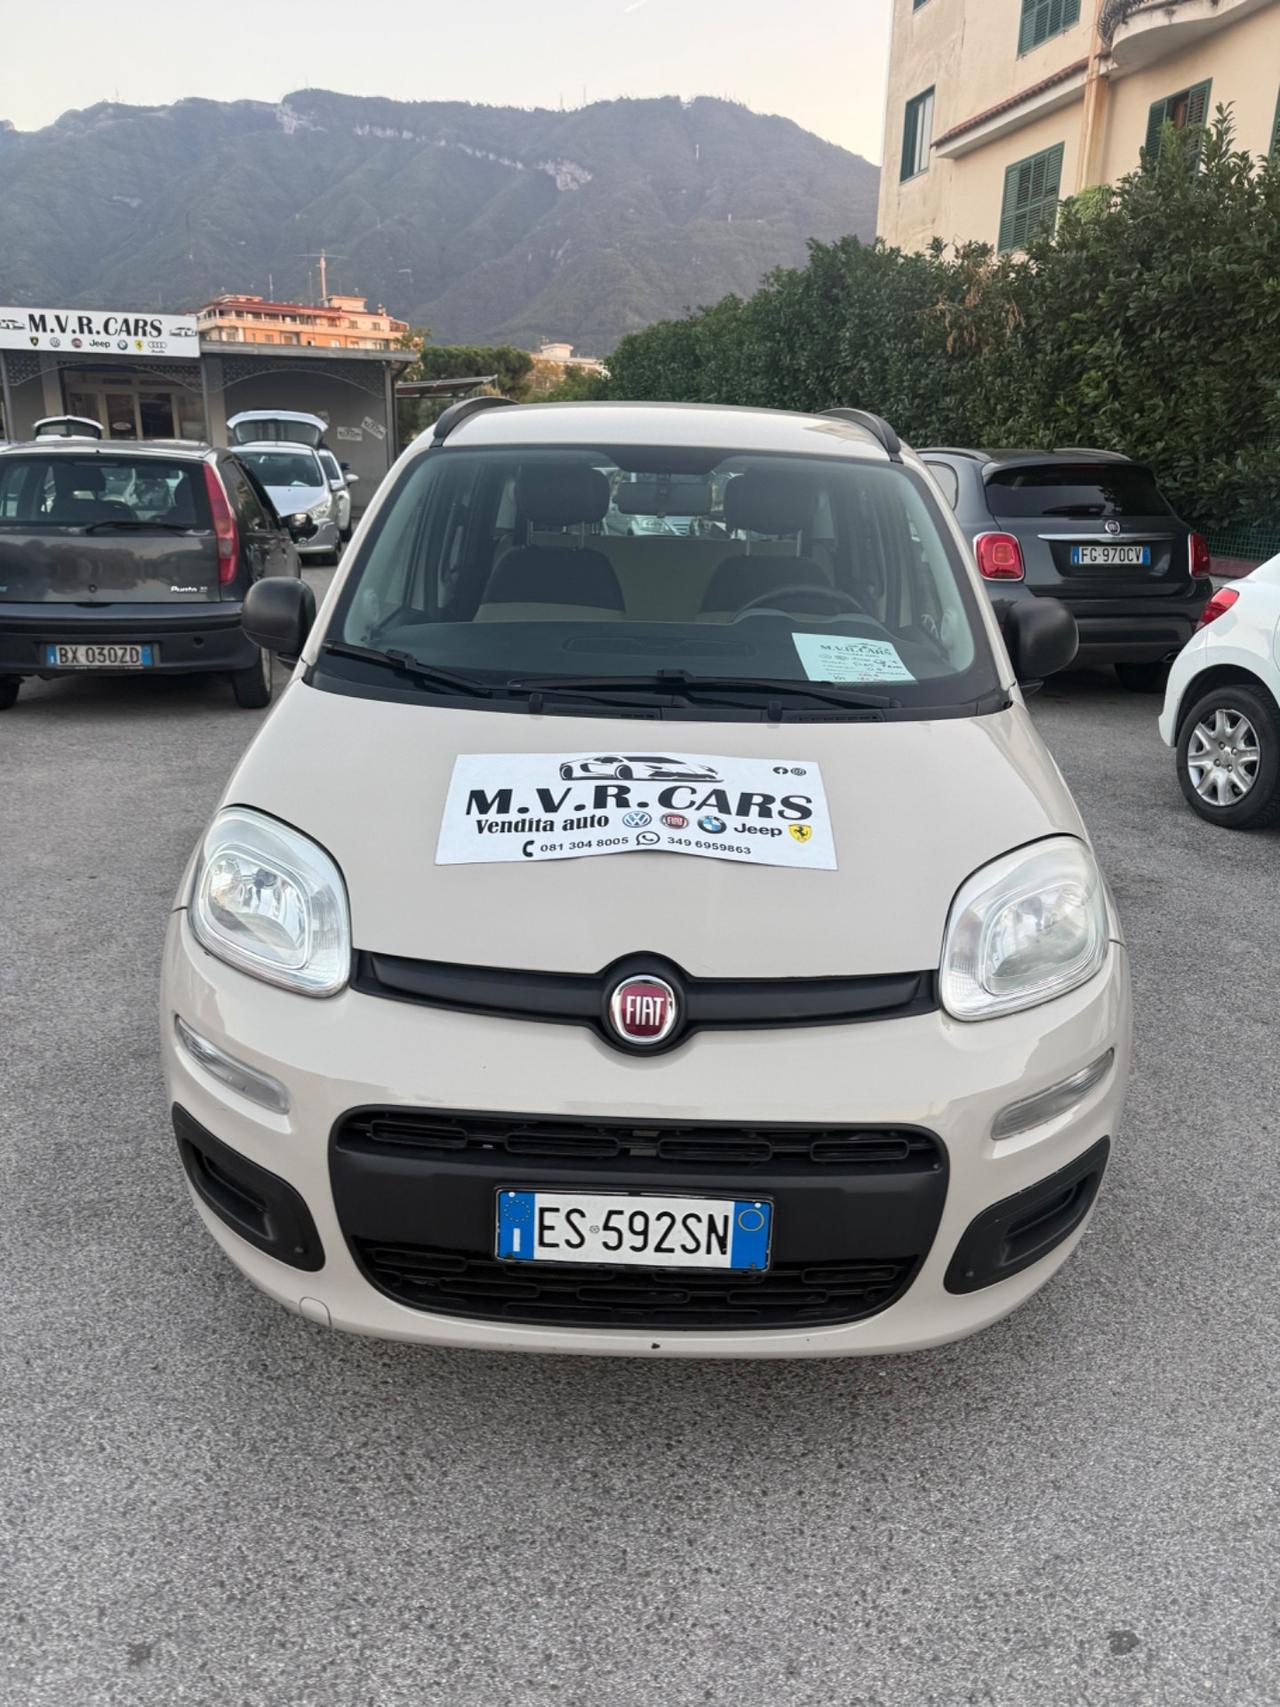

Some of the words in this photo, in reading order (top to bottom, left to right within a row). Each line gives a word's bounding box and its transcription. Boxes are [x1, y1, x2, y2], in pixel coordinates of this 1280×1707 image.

[89, 340, 111, 349] Jeep
[1081, 547, 1097, 562] FG
[1102, 547, 1142, 562] 970CV
[59, 647, 79, 664] BX
[85, 647, 140, 664] 030ZD
[475, 817, 555, 835] Vendita
[562, 814, 610, 832] auto
[734, 823, 783, 838] Jeep
[540, 843, 563, 852] 081
[569, 840, 592, 850] 304
[596, 836, 629, 848] 8005
[667, 836, 692, 848] 349
[695, 840, 752, 855] 6959863
[625, 995, 665, 1026] FIAT
[537, 1206, 586, 1250] ES
[601, 1209, 730, 1255] 592SN
